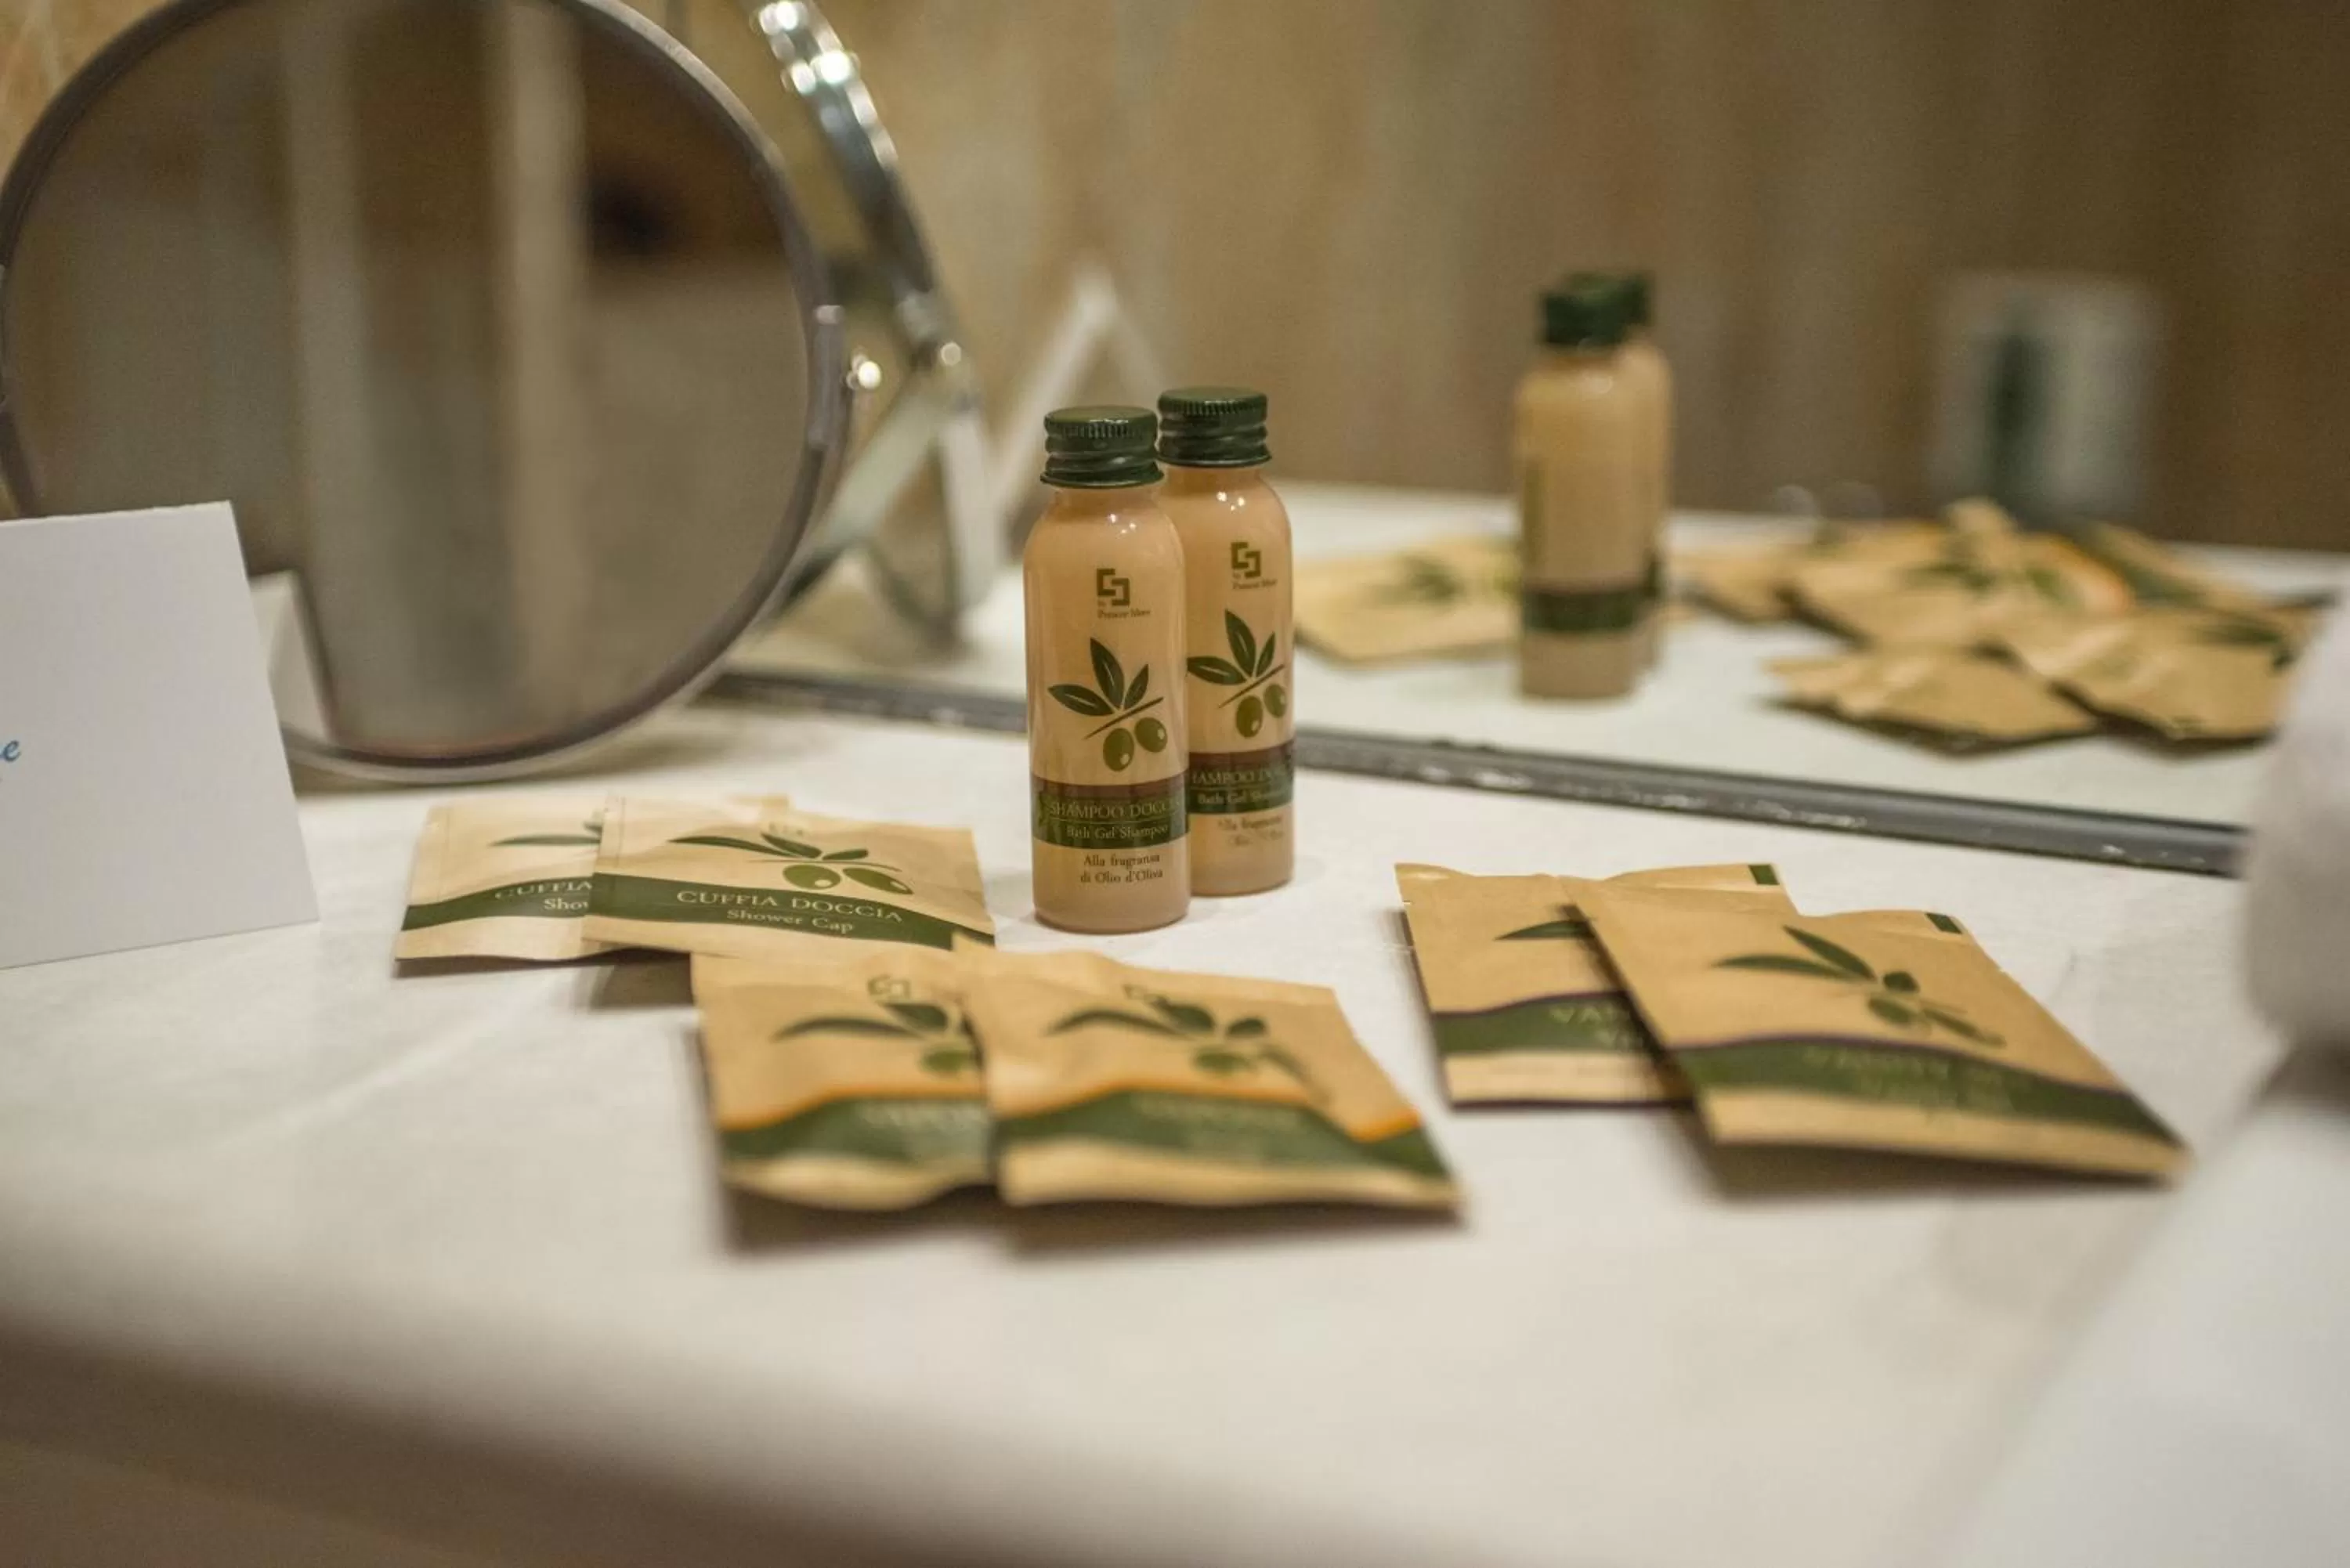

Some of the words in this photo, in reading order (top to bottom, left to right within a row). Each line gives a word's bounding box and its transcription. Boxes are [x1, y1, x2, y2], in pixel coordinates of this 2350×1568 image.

[1050, 801, 1124, 819] SHAMPOO
[1066, 826, 1090, 837] Bath
[1094, 826, 1116, 839] Gel
[1120, 824, 1169, 840] Shampoo
[1083, 854, 1105, 866] Alla
[1080, 870, 1091, 883] di
[1095, 870, 1121, 883] Olio
[1126, 868, 1163, 883] d'Oliva
[543, 897, 589, 910] Sho
[677, 890, 778, 907] CUFFIA
[792, 898, 903, 923] DOCCIA
[727, 909, 803, 925] Shower
[812, 917, 854, 934] Cap
